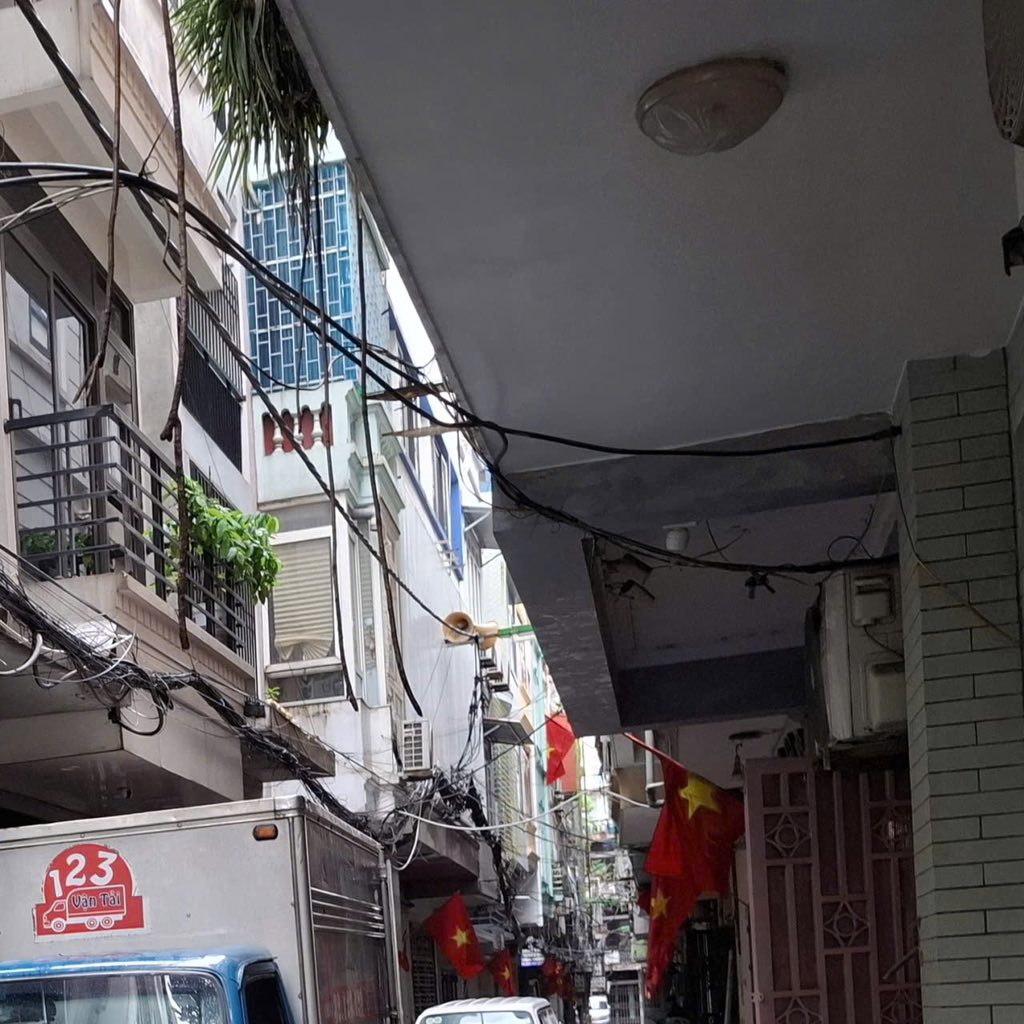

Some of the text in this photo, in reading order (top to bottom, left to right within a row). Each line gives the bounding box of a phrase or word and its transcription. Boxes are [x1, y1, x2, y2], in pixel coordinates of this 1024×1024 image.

[49, 851, 117, 897] 123
[72, 890, 121, 911] Vận Tải
